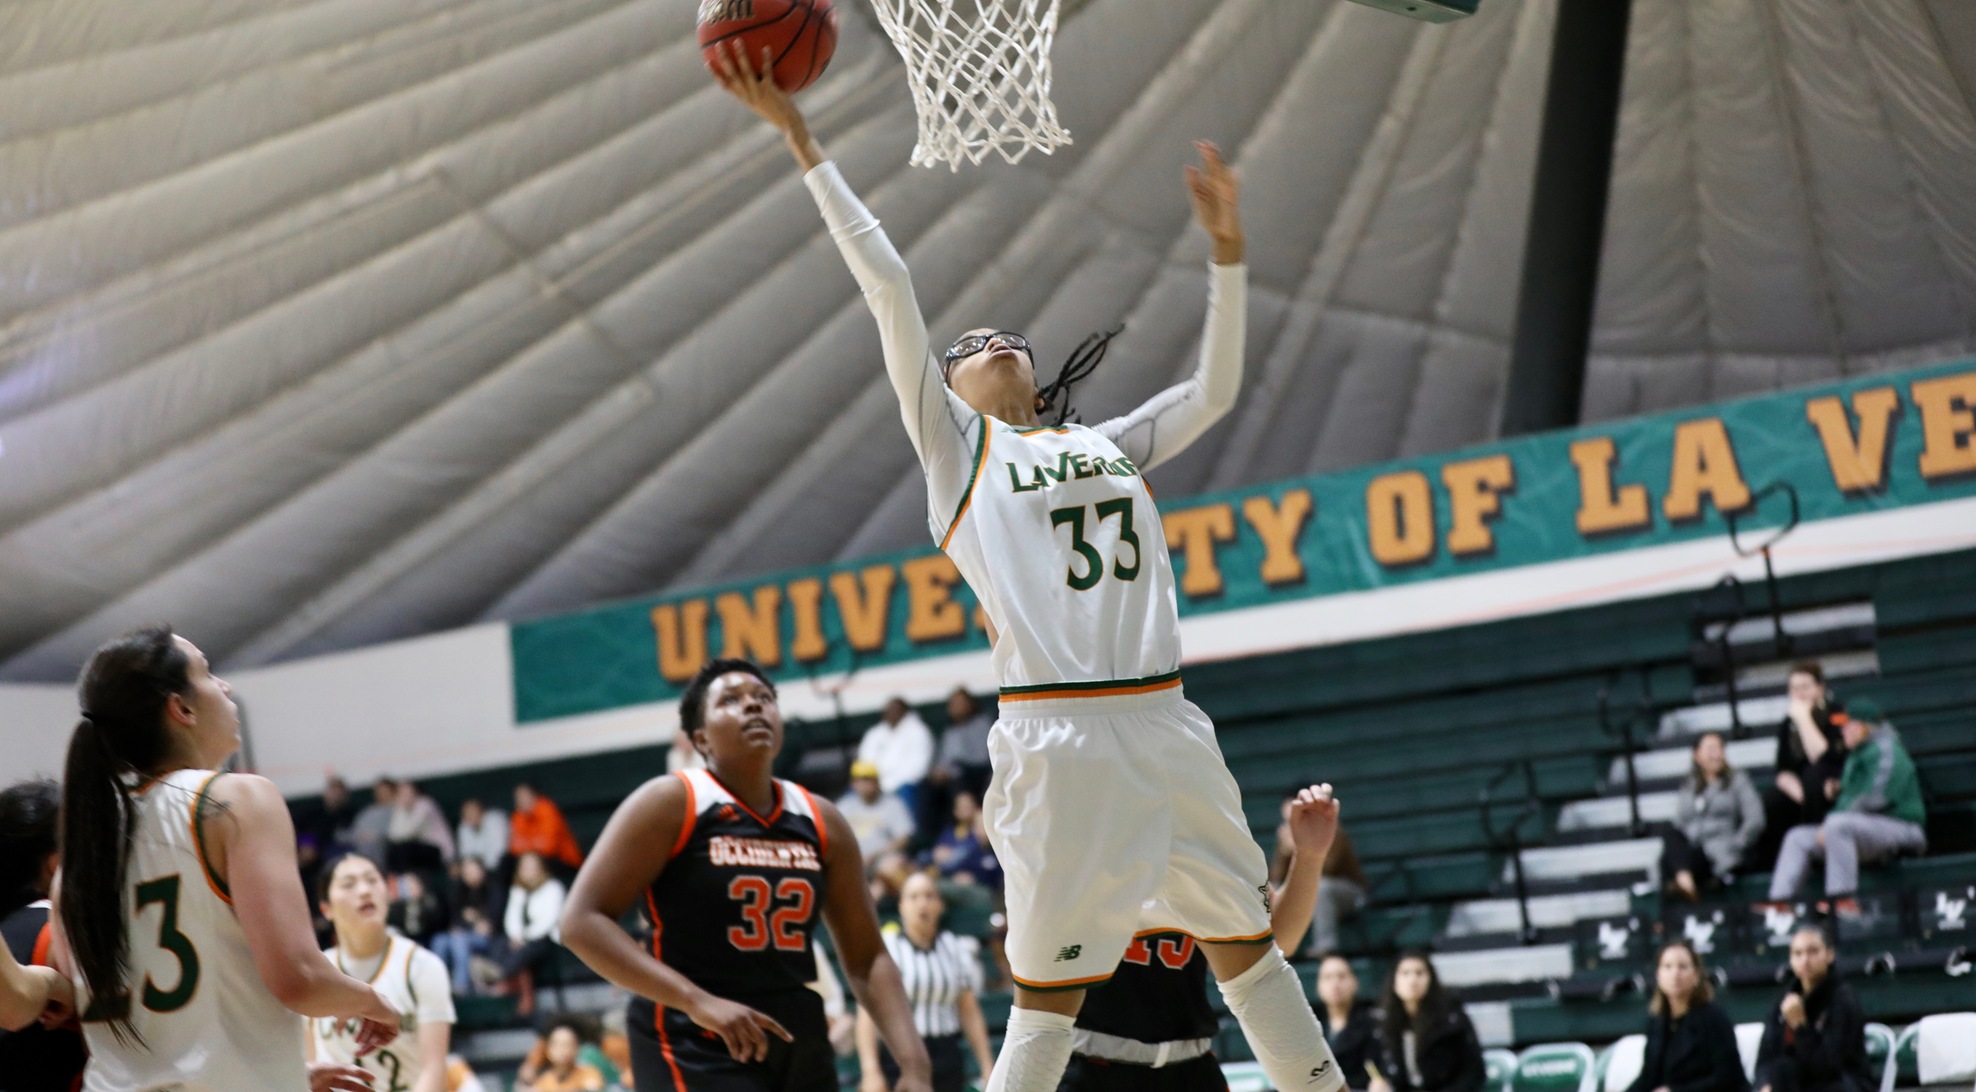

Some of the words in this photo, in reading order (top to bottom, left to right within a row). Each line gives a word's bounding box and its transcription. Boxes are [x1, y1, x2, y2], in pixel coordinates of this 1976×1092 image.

[652, 489, 1313, 682] UNIVETY
[1366, 456, 1514, 565] OF
[1570, 417, 1753, 536] LA
[1050, 497, 1141, 591] 33
[728, 875, 814, 951] 32
